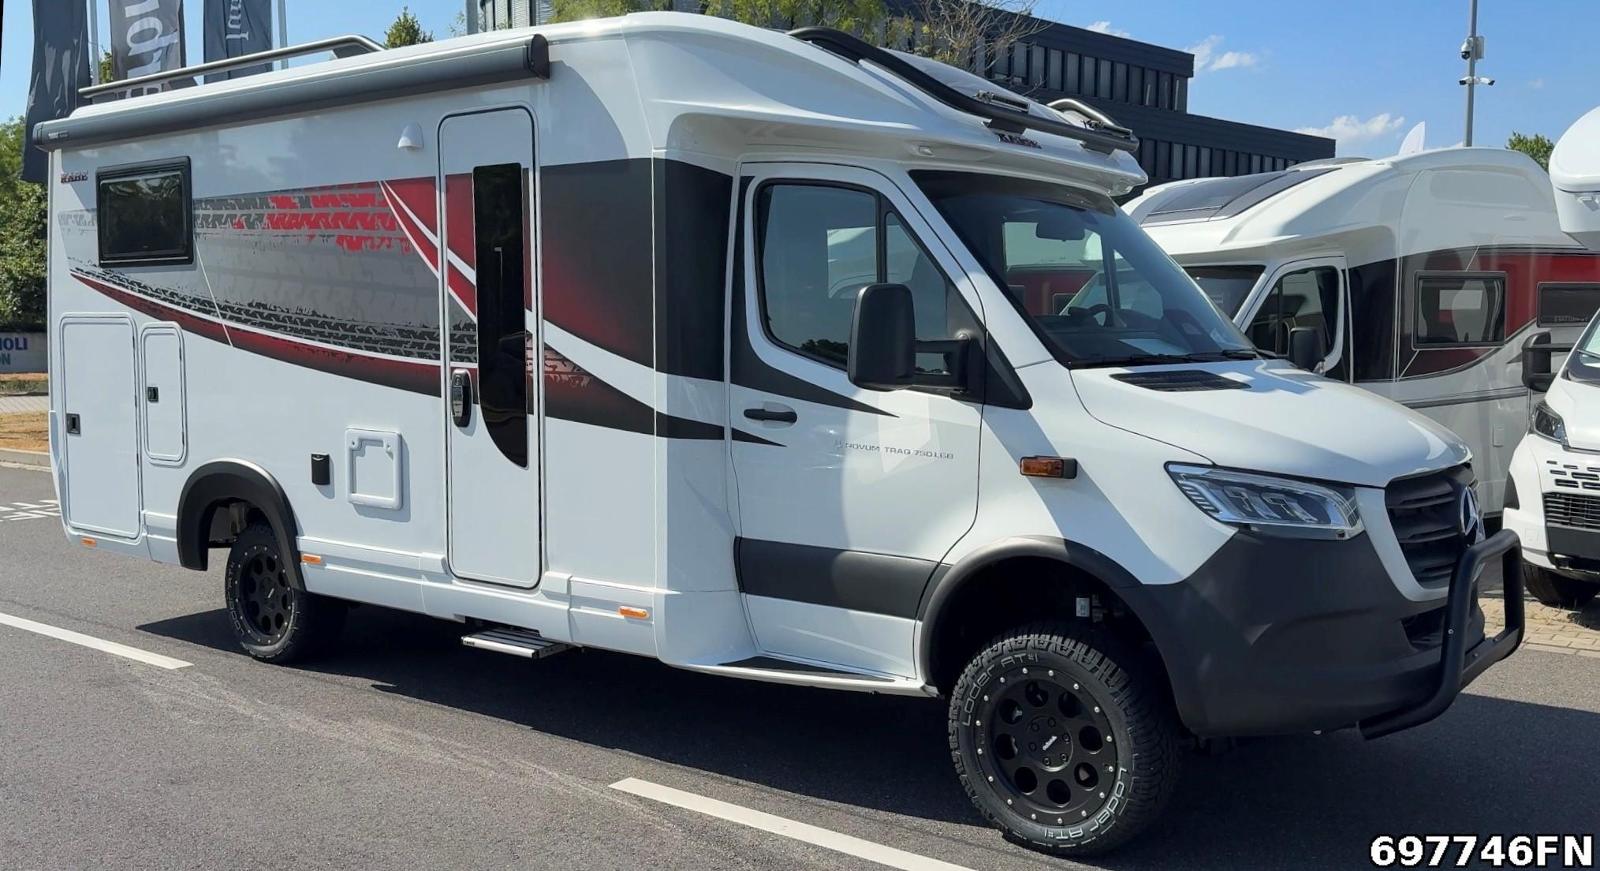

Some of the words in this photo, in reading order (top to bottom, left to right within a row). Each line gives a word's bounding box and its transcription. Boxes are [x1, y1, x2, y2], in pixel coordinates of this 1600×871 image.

[0, 336, 28, 351] OLI
[962, 664, 995, 727] Loder
[1089, 767, 1128, 832] Loder
